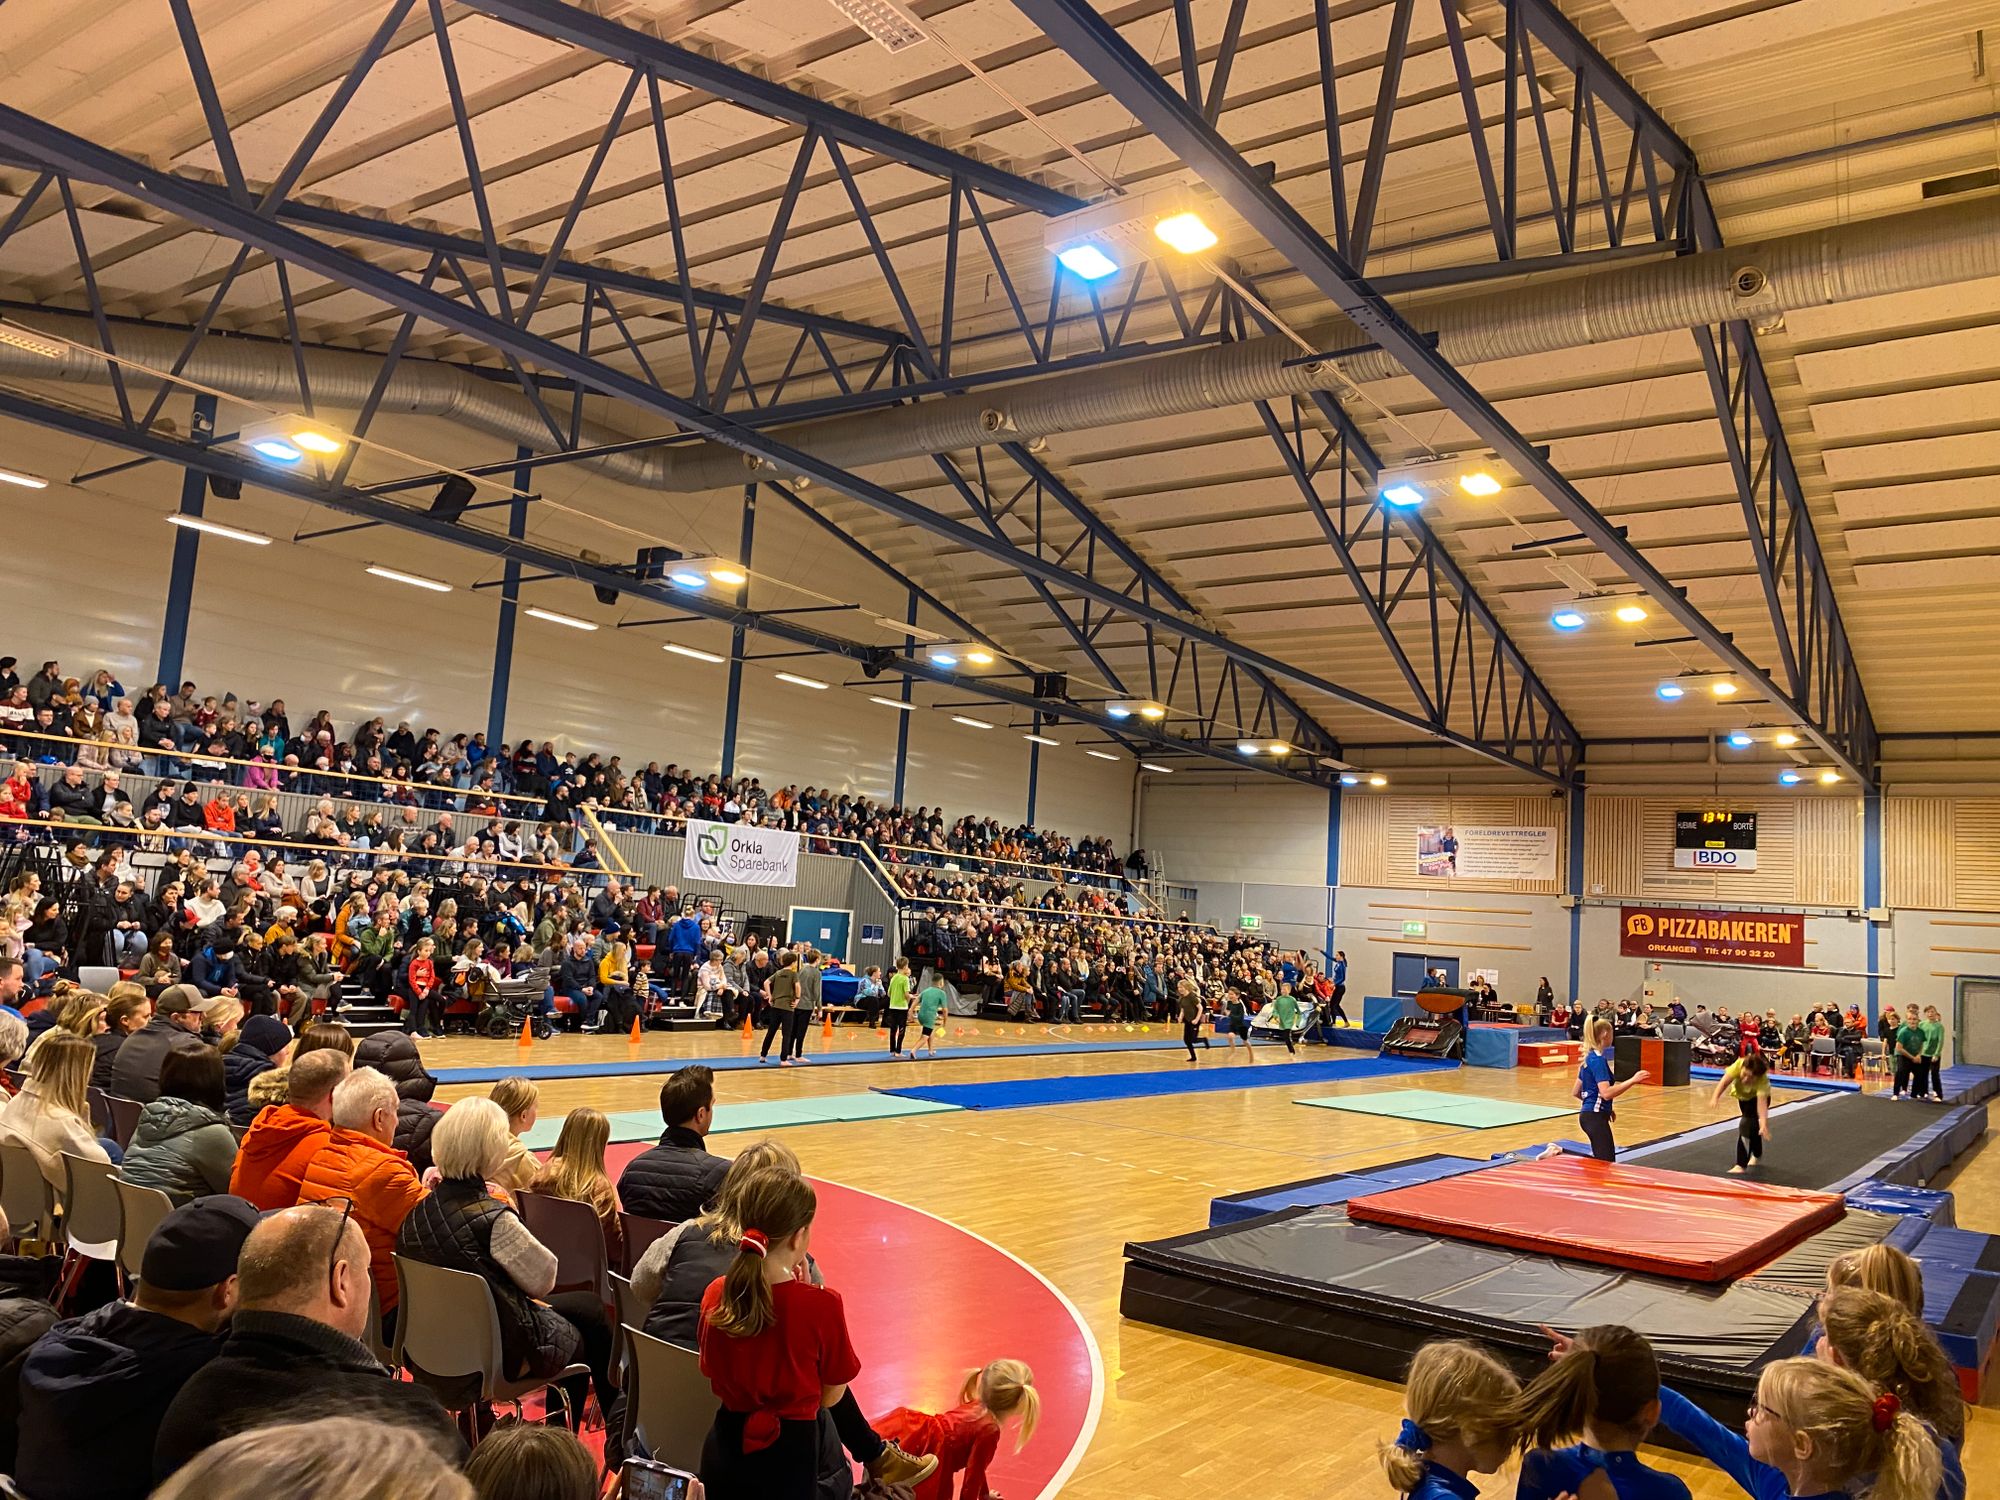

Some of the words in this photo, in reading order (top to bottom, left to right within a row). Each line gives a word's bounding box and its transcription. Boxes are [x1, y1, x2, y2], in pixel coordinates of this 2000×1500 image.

[1733, 822, 1753, 830] BORTE
[731, 838, 763, 855] Orkla
[730, 854, 789, 873] Sparebank
[1698, 850, 1737, 864] BDO
[1633, 918, 1648, 933] PB
[1658, 917, 1792, 944] PIZZABAKEREN
[1647, 943, 1697, 954] ORKANGER
[1720, 948, 1733, 956] 47
[1748, 950, 1761, 958] 32
[1762, 950, 1776, 959] 20
